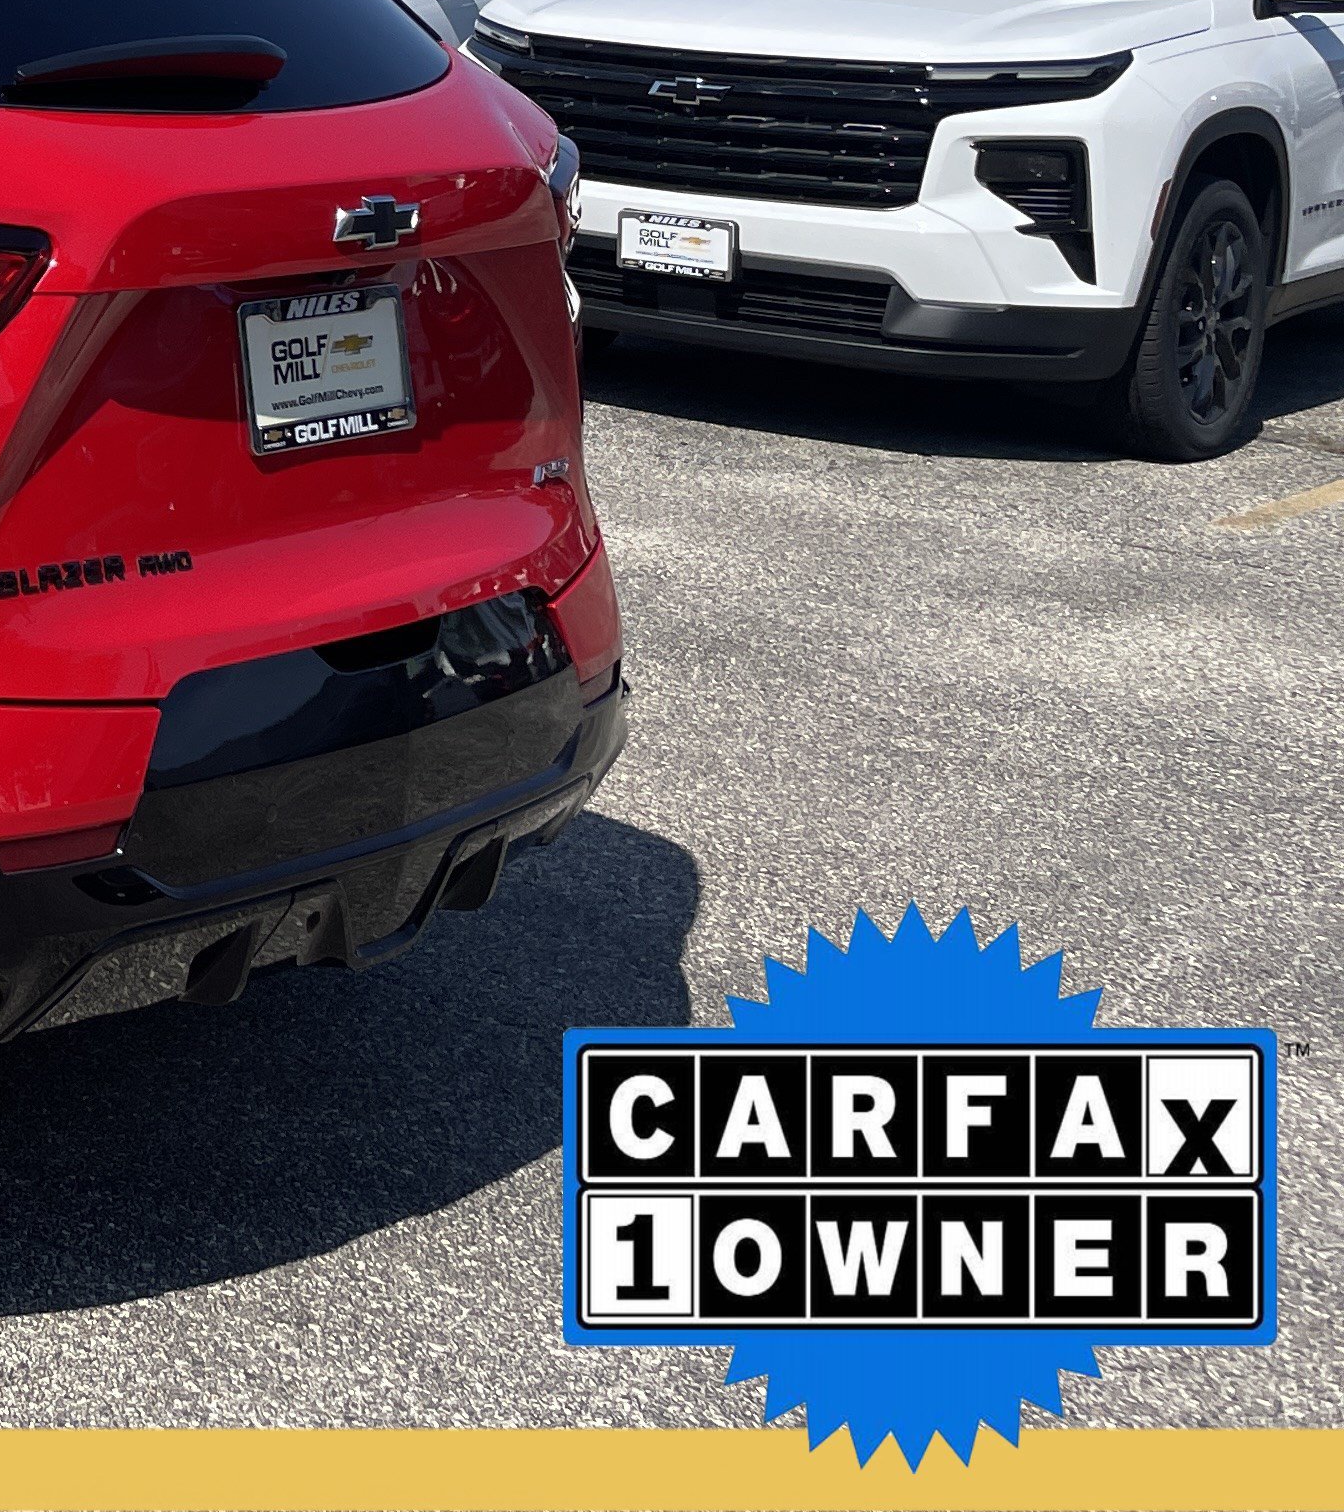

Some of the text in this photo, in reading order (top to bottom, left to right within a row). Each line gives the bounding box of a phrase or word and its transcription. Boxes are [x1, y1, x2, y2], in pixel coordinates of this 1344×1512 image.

[639, 228, 679, 241] GOLF
[649, 214, 702, 228] NILES
[639, 236, 671, 249] MILL
[644, 261, 704, 277] GOLF MILL
[286, 291, 361, 321] NILES
[270, 333, 328, 363] GOLF
[273, 358, 322, 386] MILL
[271, 384, 385, 412] www.GolfMillChevy.com
[294, 413, 379, 445] GOLF MILL
